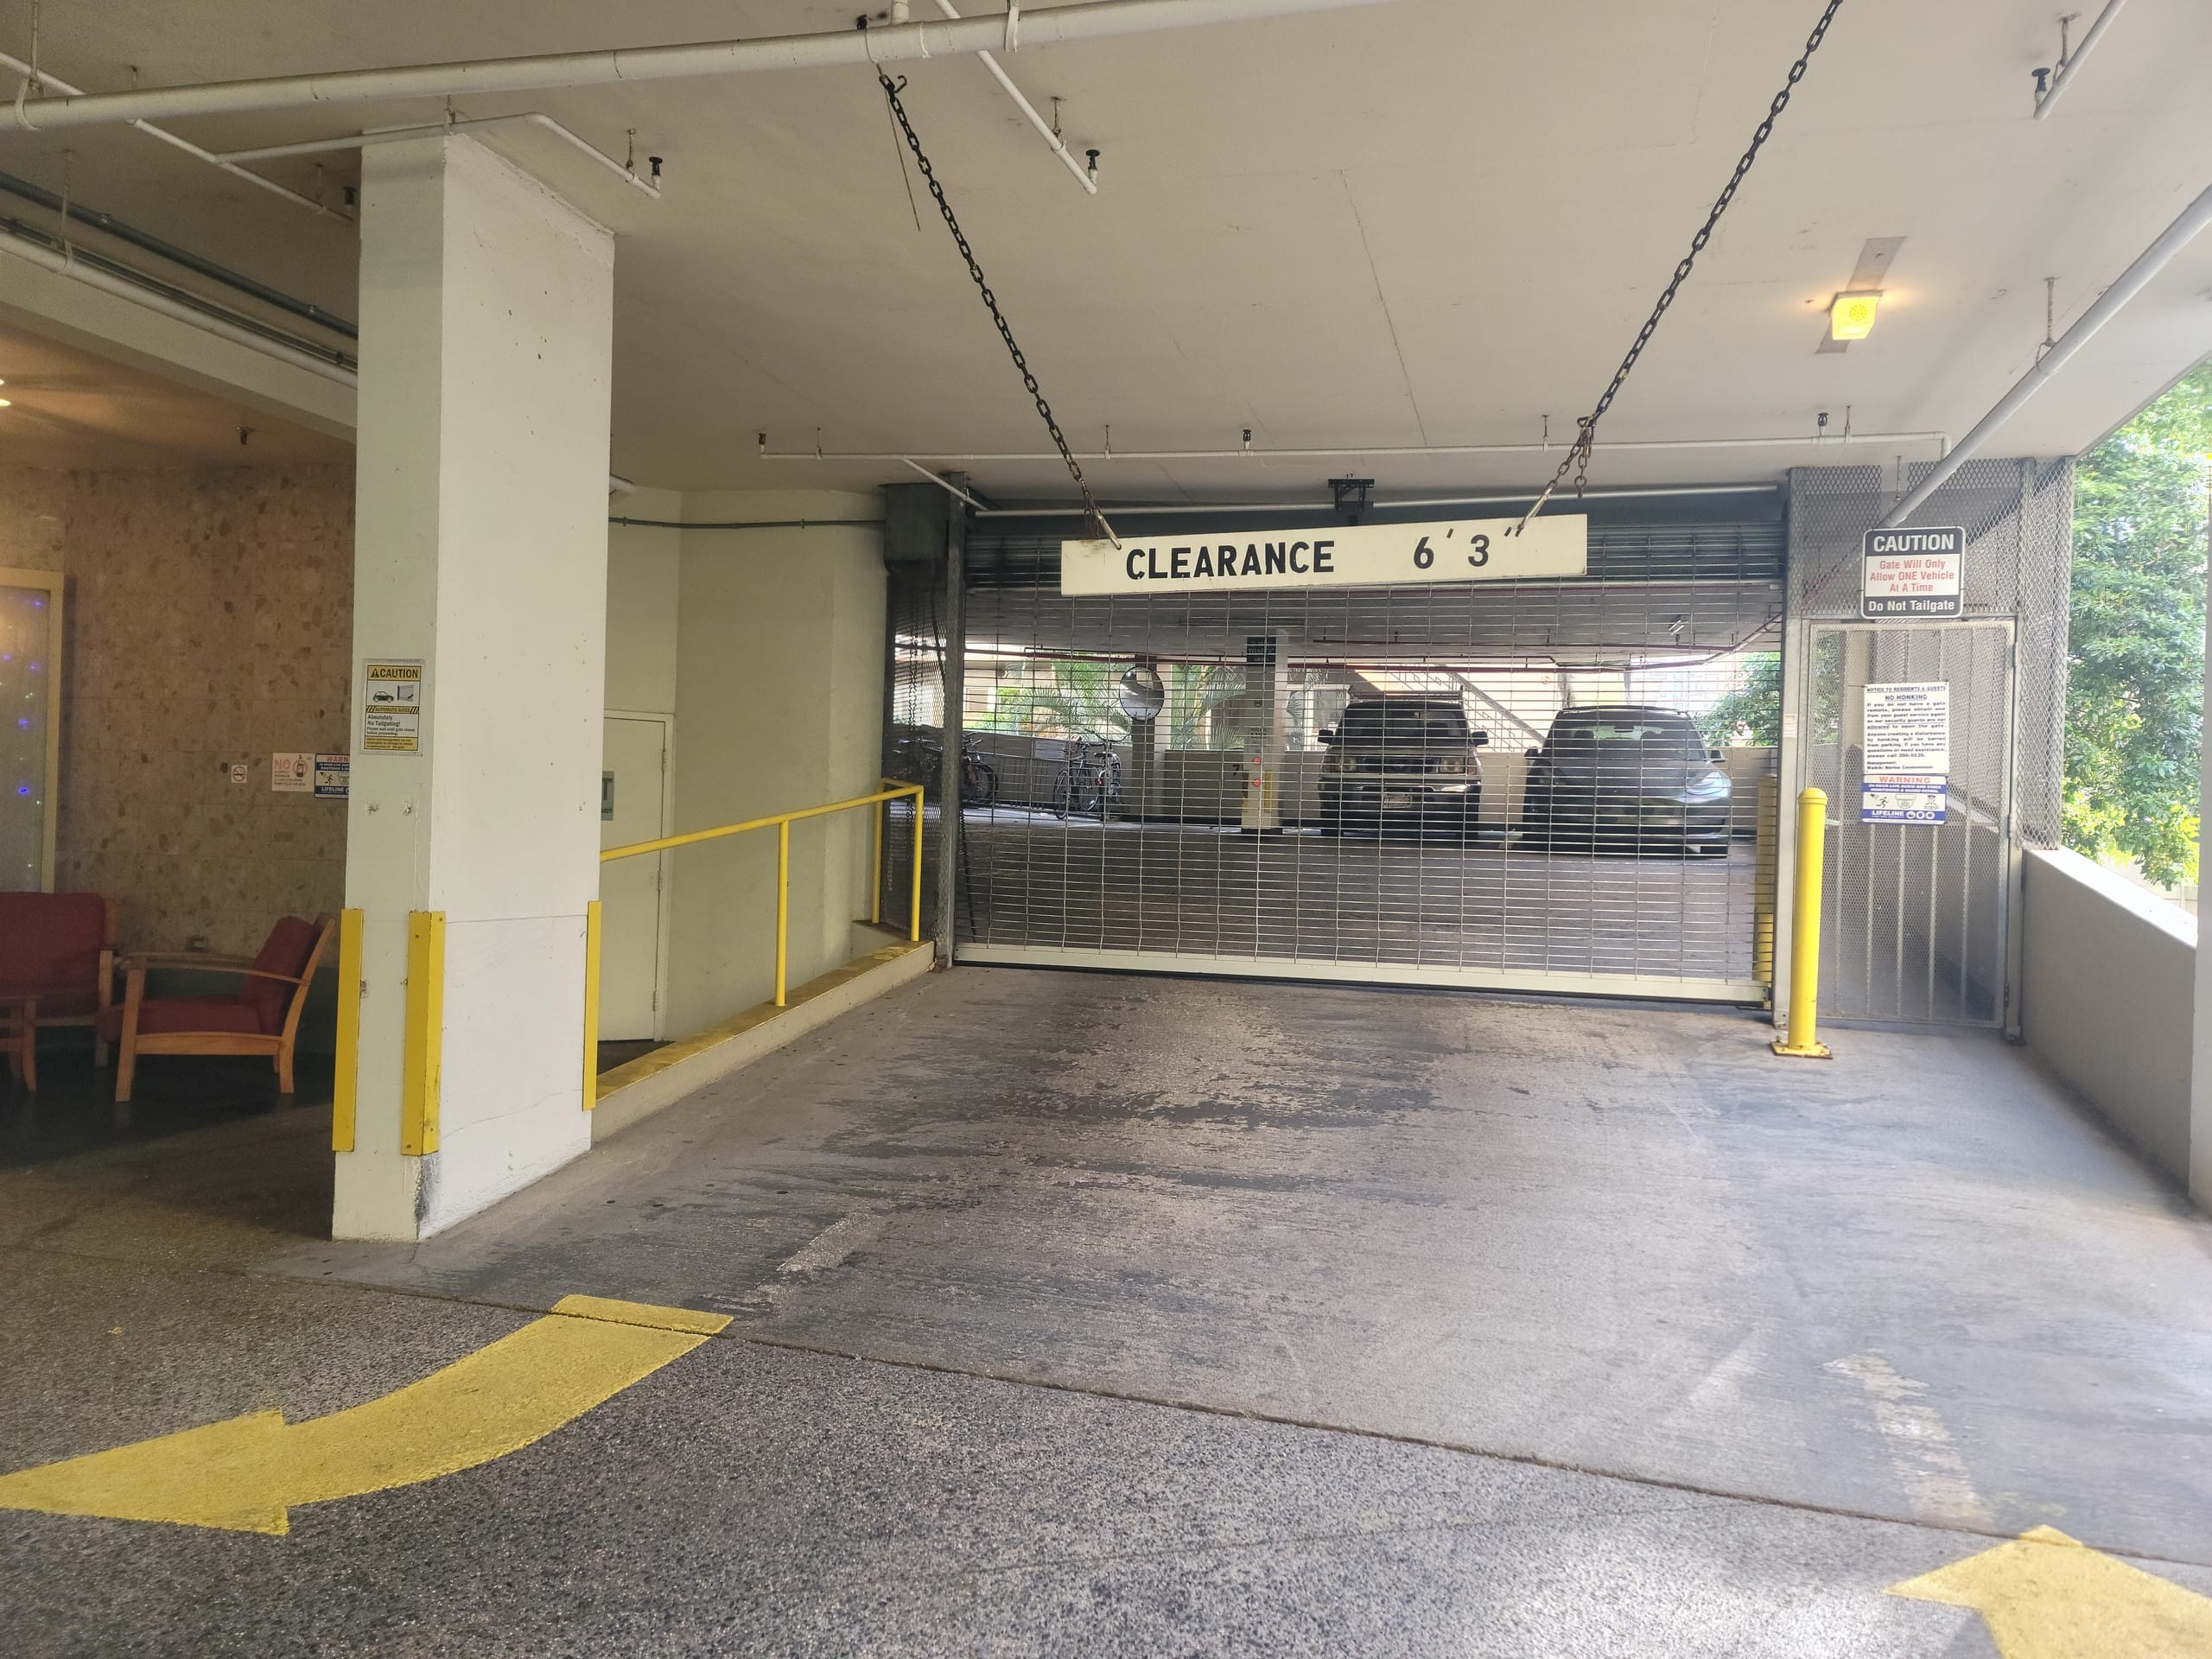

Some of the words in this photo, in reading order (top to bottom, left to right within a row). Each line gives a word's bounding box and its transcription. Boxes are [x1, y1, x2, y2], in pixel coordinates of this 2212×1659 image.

[1873, 534, 1955, 552] CAUTION
[1126, 540, 1335, 580] CLEARANCE
[1879, 560, 1900, 569] Gate
[1904, 560, 1922, 569] Will
[1925, 559, 1946, 569] Only
[1870, 572, 1895, 582] Allow
[1898, 571, 1917, 581] ONE
[1920, 571, 1955, 580] Vehicle
[1890, 583, 1899, 593] At
[1902, 583, 1908, 592] A
[1911, 583, 1934, 592] Time
[1868, 601, 1884, 612] Do
[1887, 601, 1906, 611] Not
[1910, 600, 1955, 612] Tailgate
[380, 668, 418, 678] CAUTION
[275, 760, 291, 770] NO
